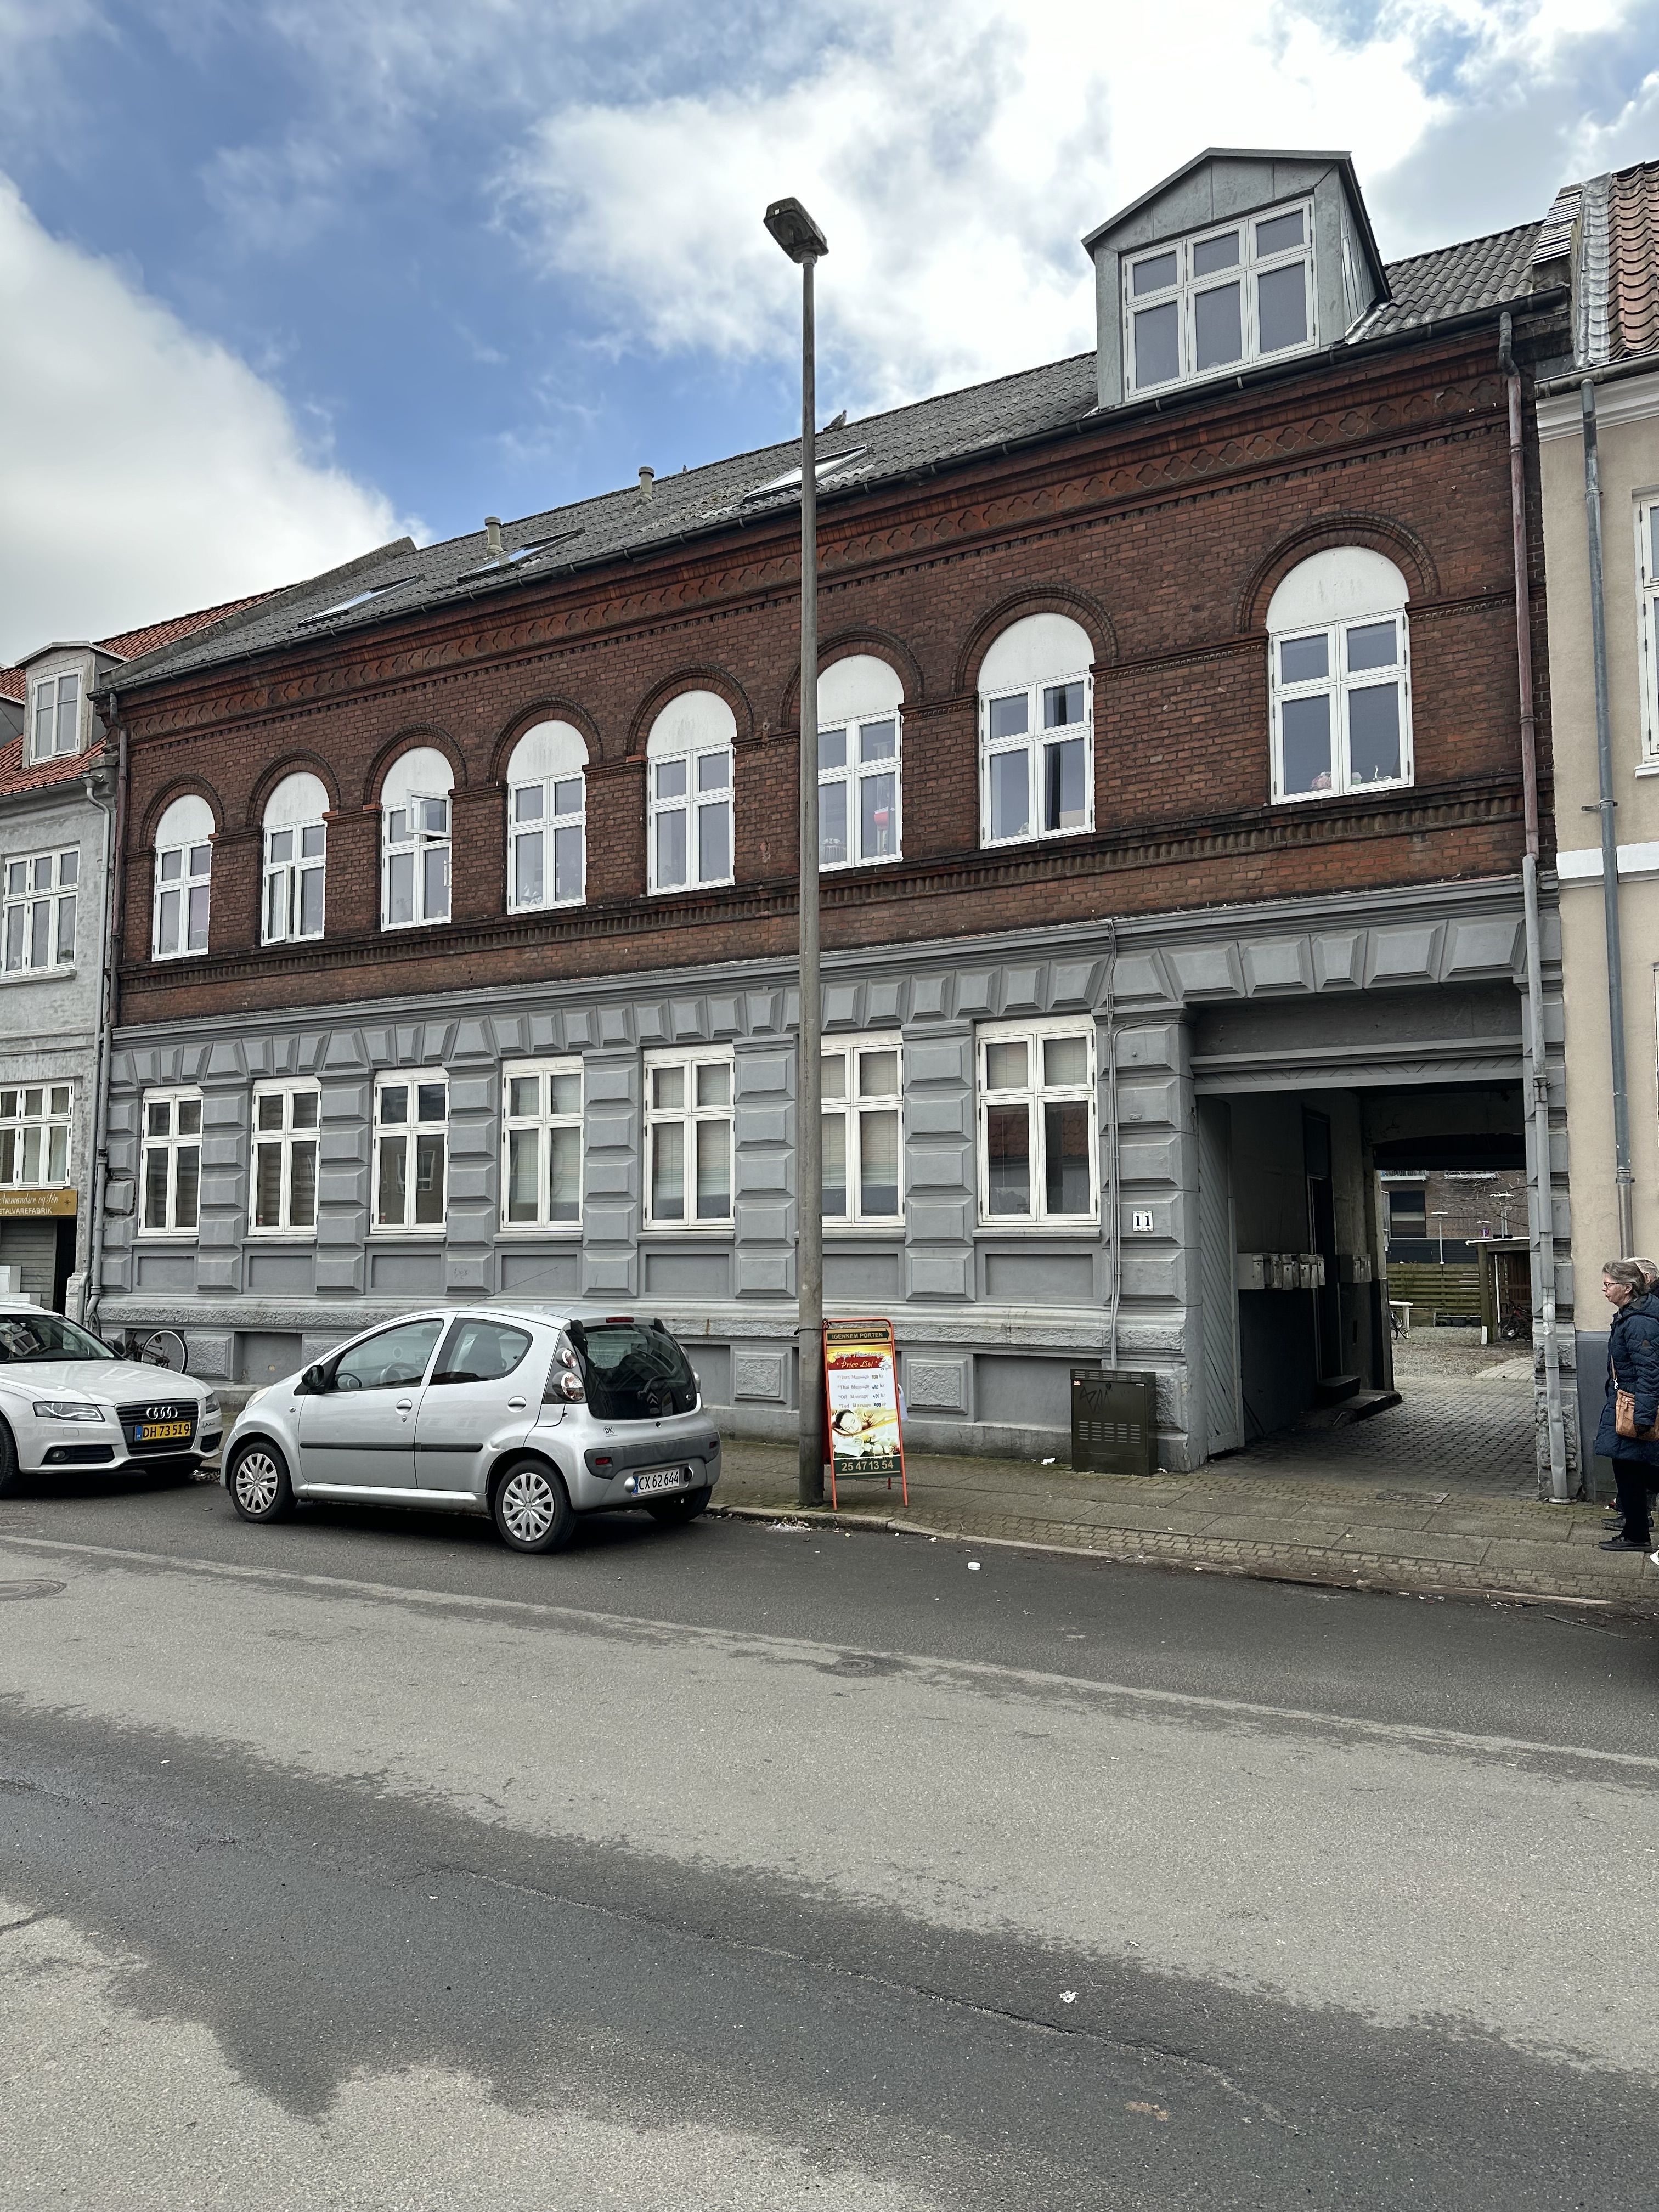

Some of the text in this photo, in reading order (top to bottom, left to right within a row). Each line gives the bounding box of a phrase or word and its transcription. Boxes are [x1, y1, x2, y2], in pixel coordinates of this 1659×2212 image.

[38, 1197, 45, 1207] og
[1136, 1215, 1150, 1226] 11
[143, 1424, 190, 1438] DH 73 519
[842, 1460, 894, 1471] 25 47 13 54
[639, 1471, 679, 1490] CX 62 644
